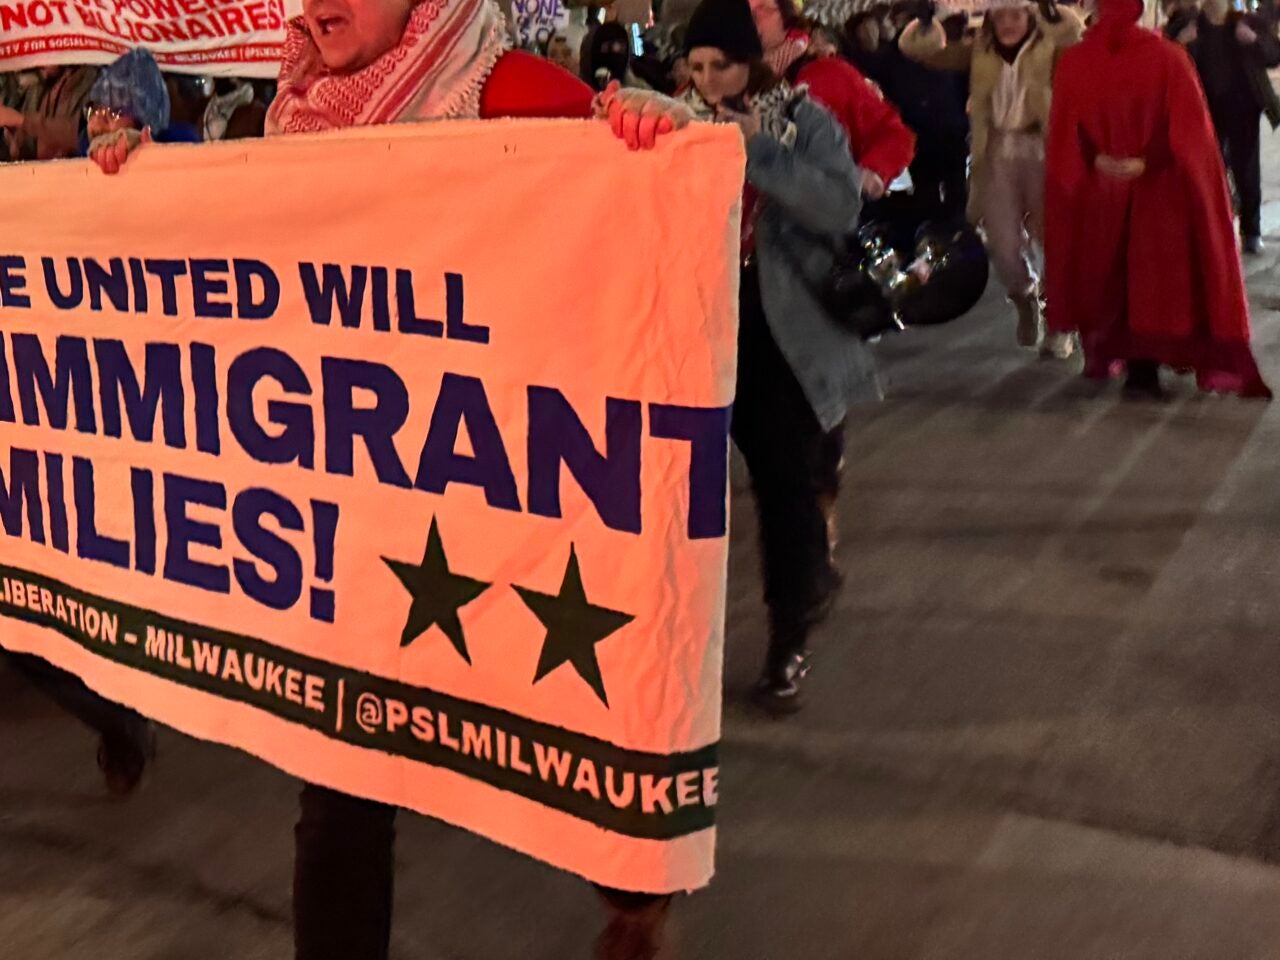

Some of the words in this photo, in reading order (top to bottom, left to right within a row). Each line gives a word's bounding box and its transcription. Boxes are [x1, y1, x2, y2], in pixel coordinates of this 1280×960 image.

[0, 0, 69, 33] NOT
[41, 256, 280, 320] UNITED
[298, 261, 490, 344] WILL
[144, 625, 326, 712] MILWAUKEE
[355, 692, 720, 815] @PSLMILWAUKEE
